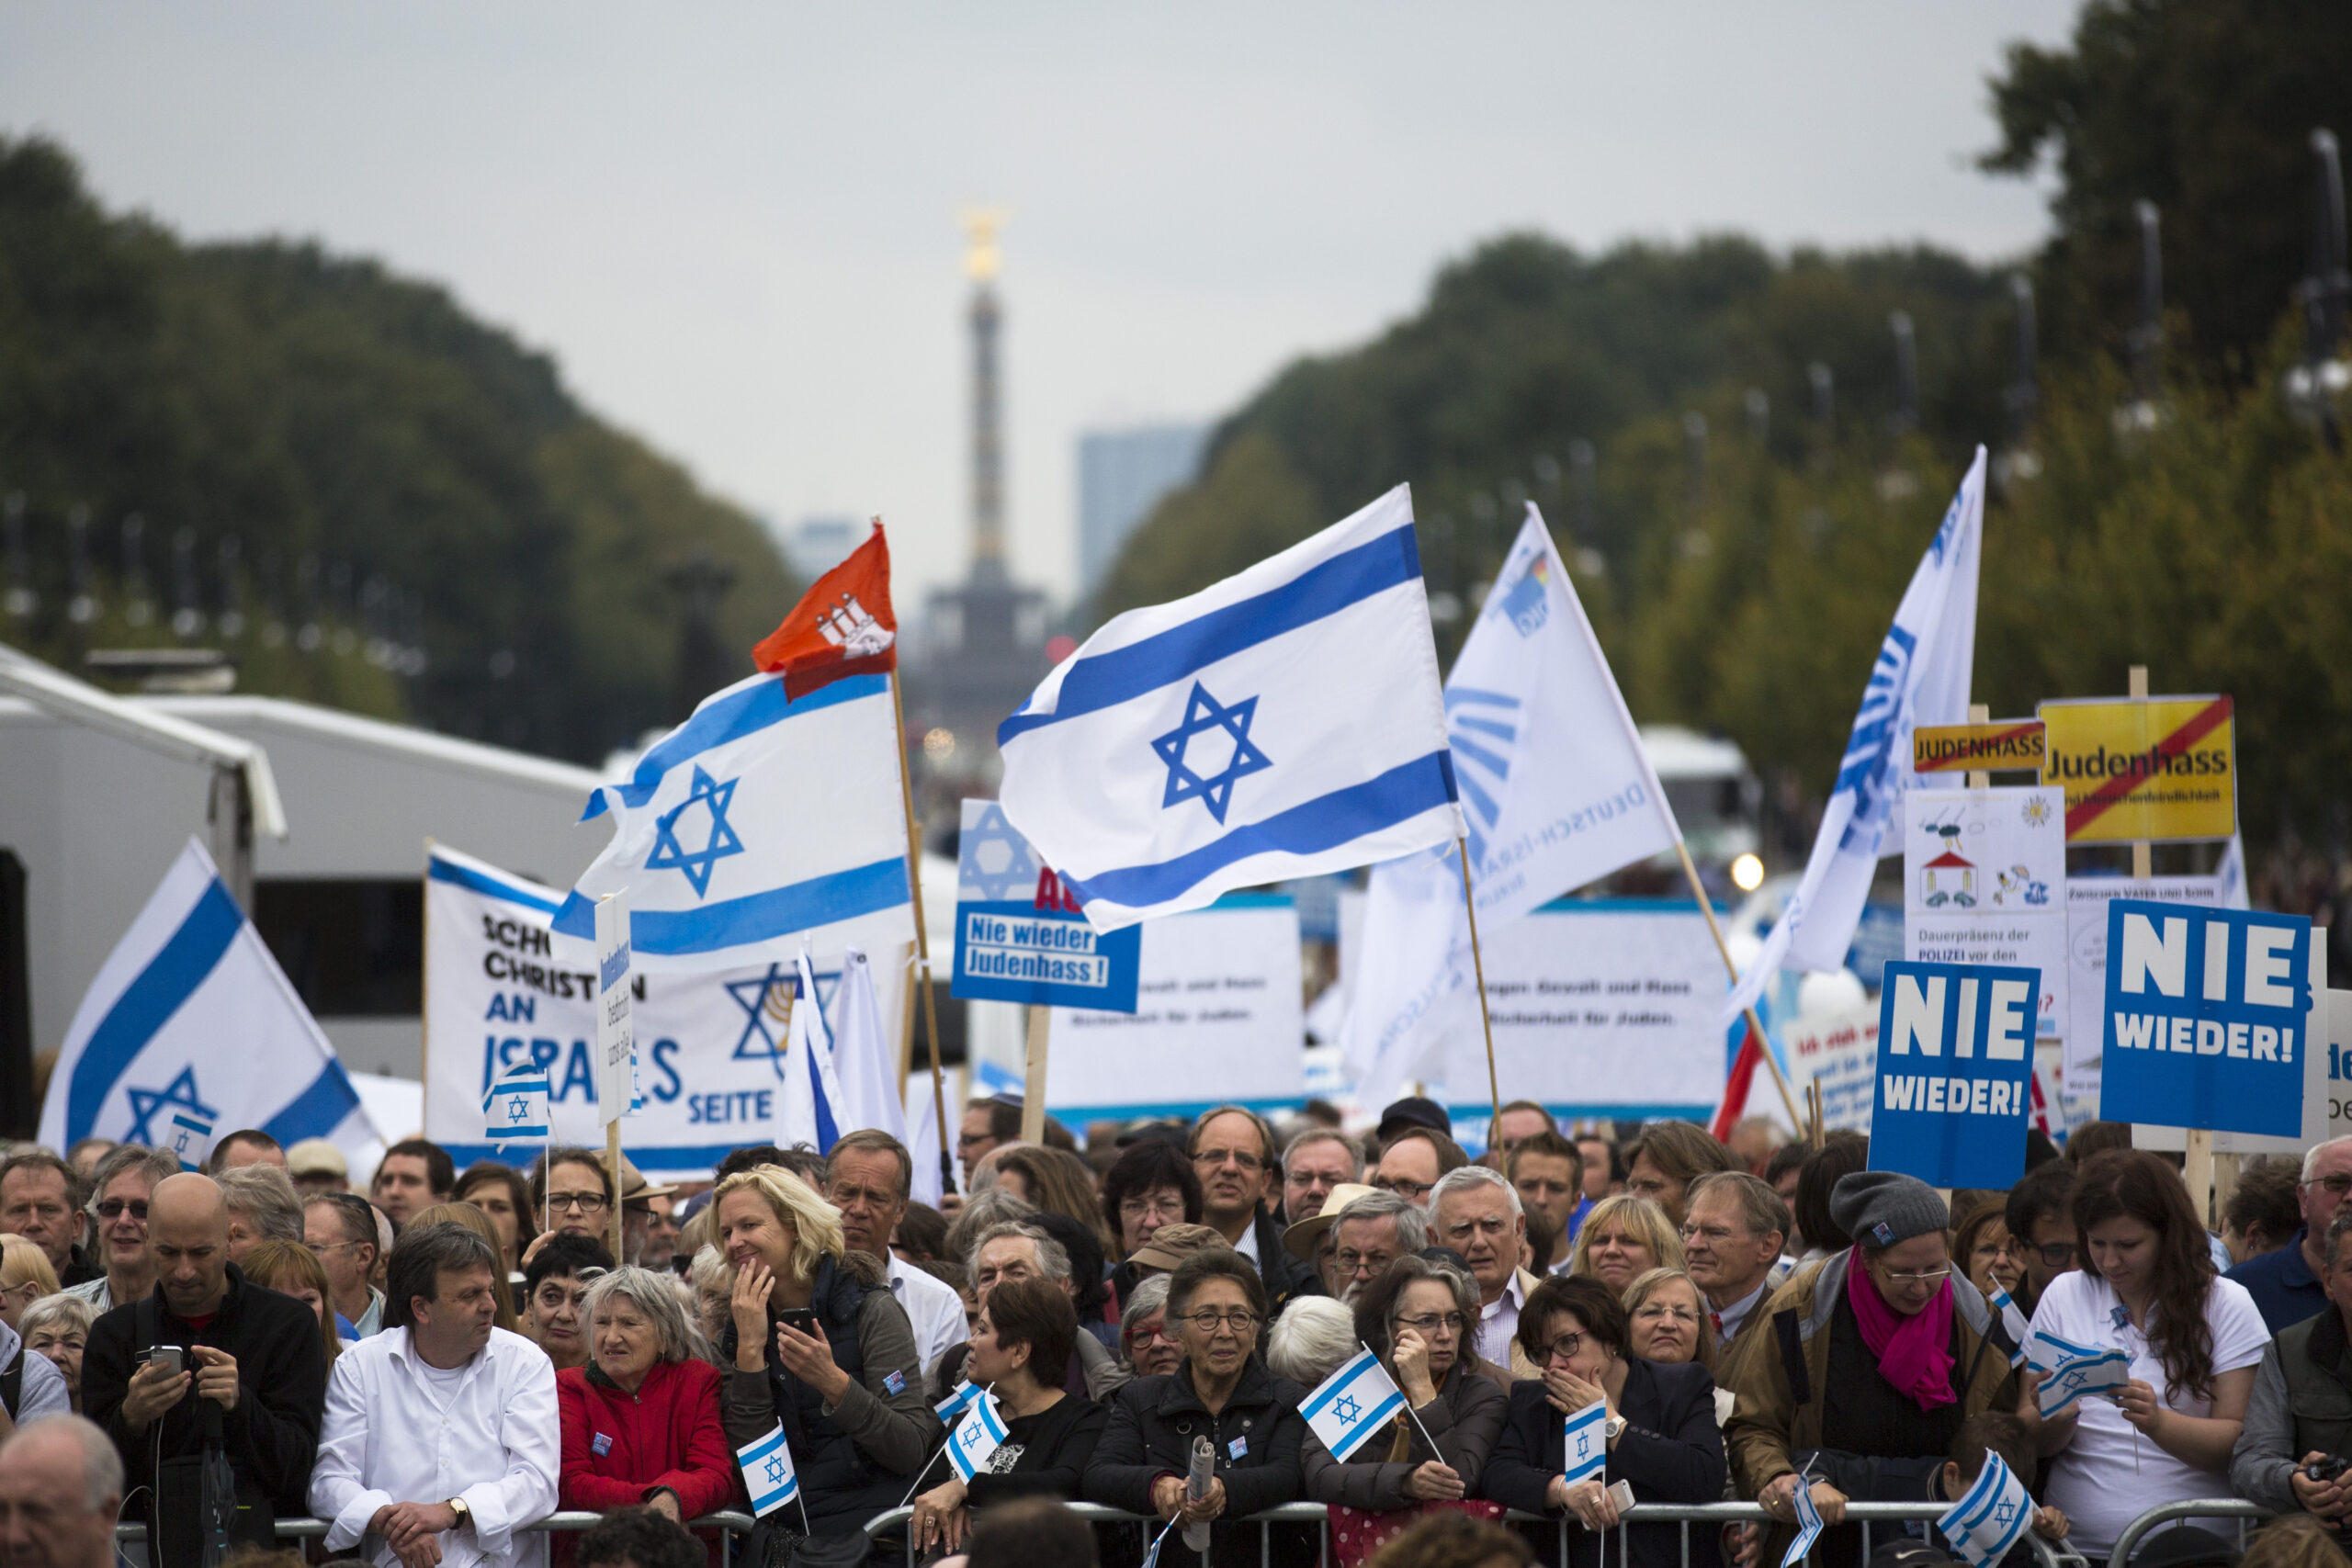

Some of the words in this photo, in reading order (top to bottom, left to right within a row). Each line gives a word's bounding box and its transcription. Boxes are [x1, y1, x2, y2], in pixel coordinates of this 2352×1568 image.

[1917, 735, 2043, 761] JUDENHASS
[2048, 745, 2228, 779] Judenhass
[2123, 886, 2156, 899] VATER
[971, 916, 1007, 942] Nie
[1012, 921, 1092, 950] wieder
[1918, 930, 2004, 943] Dauerpräsenz
[2008, 928, 2030, 942] der
[1918, 949, 1964, 962] POLIZEI
[1968, 951, 1987, 962] vor
[1992, 949, 2017, 962] den
[2120, 913, 2296, 1009] NIE
[483, 950, 647, 1001] CHRISTN
[485, 992, 536, 1022] AN
[1890, 975, 2030, 1061] NIE
[2114, 1012, 2294, 1064] WIEDER!
[481, 1035, 682, 1105] ISRAS
[688, 1089, 773, 1124] SEITE
[1883, 1074, 2022, 1116] WIEDER!
